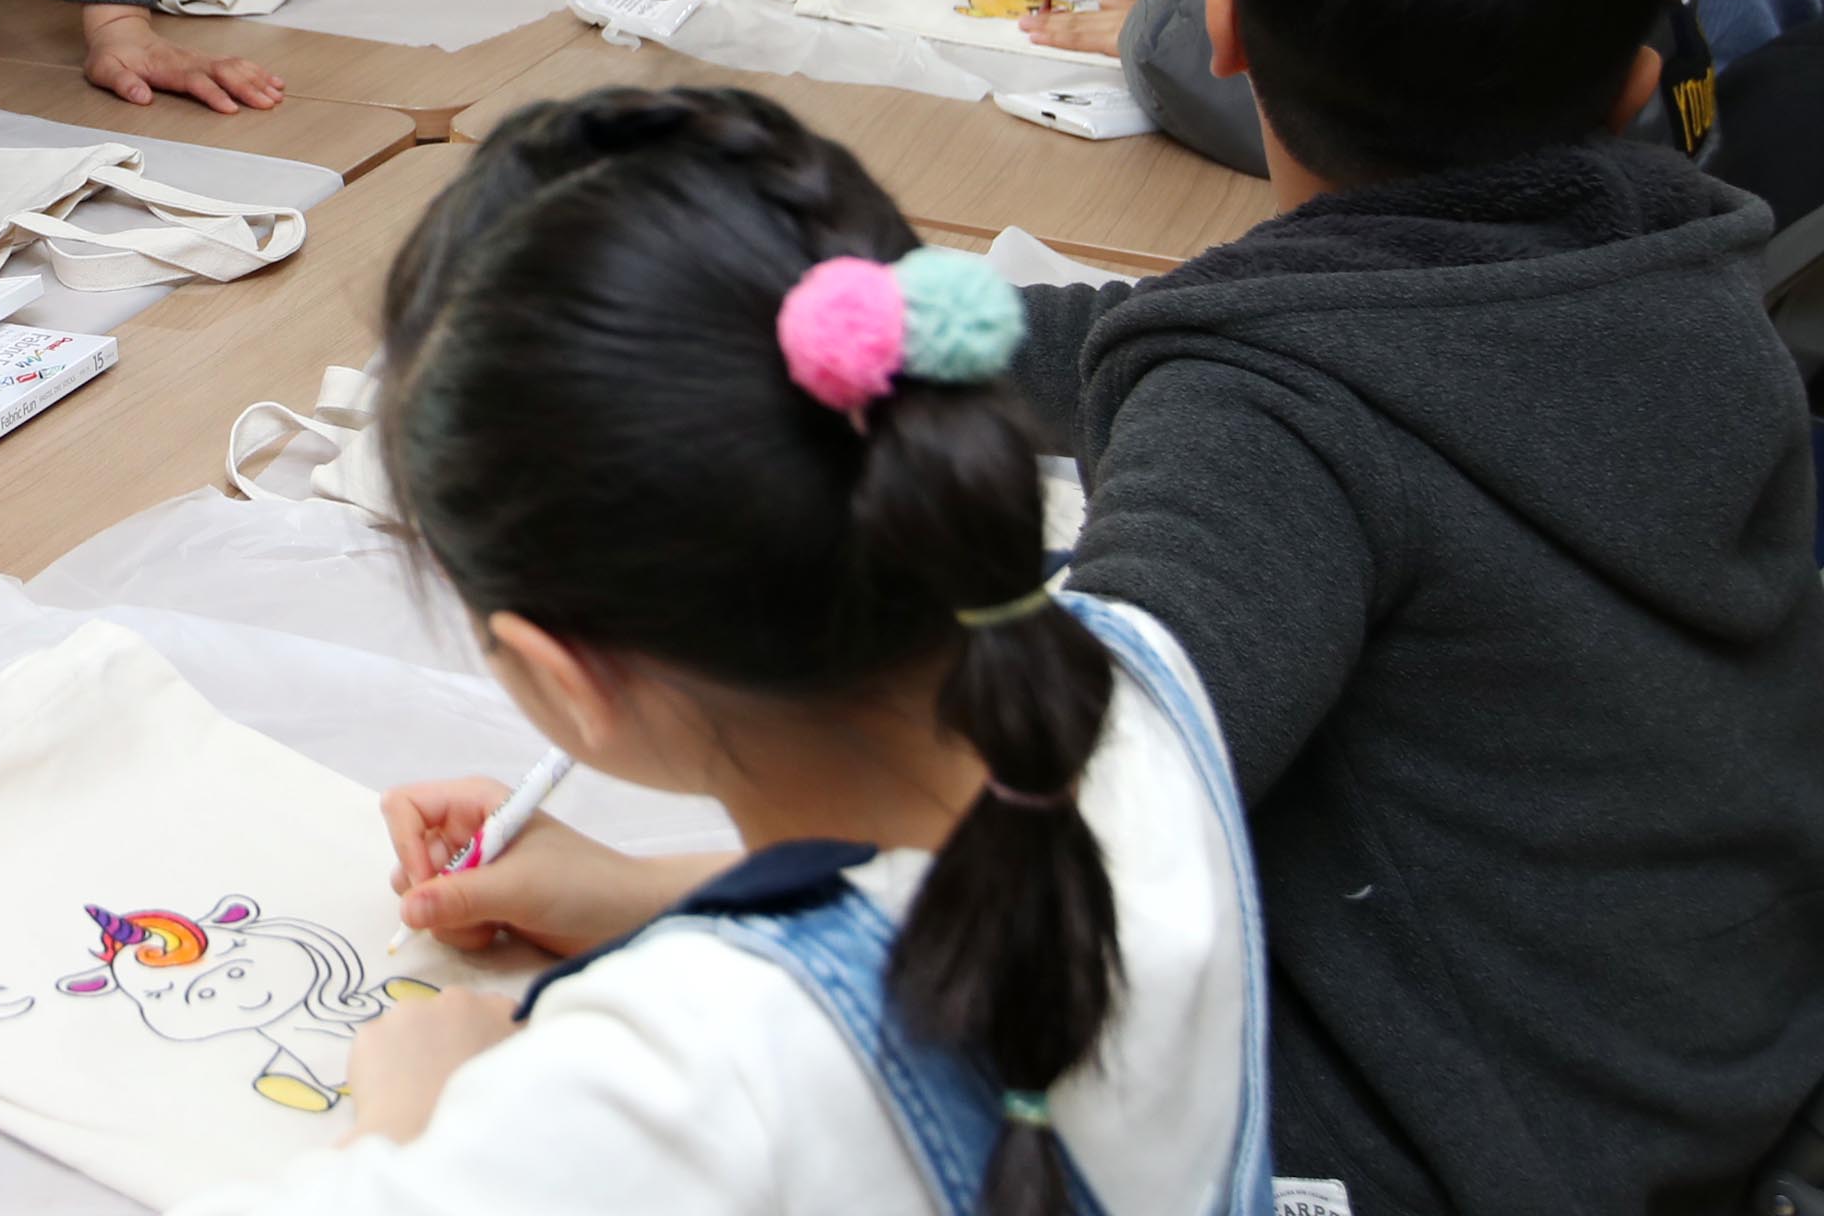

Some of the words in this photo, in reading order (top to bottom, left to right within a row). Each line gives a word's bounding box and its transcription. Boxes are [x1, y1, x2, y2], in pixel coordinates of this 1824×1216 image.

[92, 351, 105, 372] 15
[0, 406, 23, 430] Fabric
[22, 399, 37, 417] Fun
